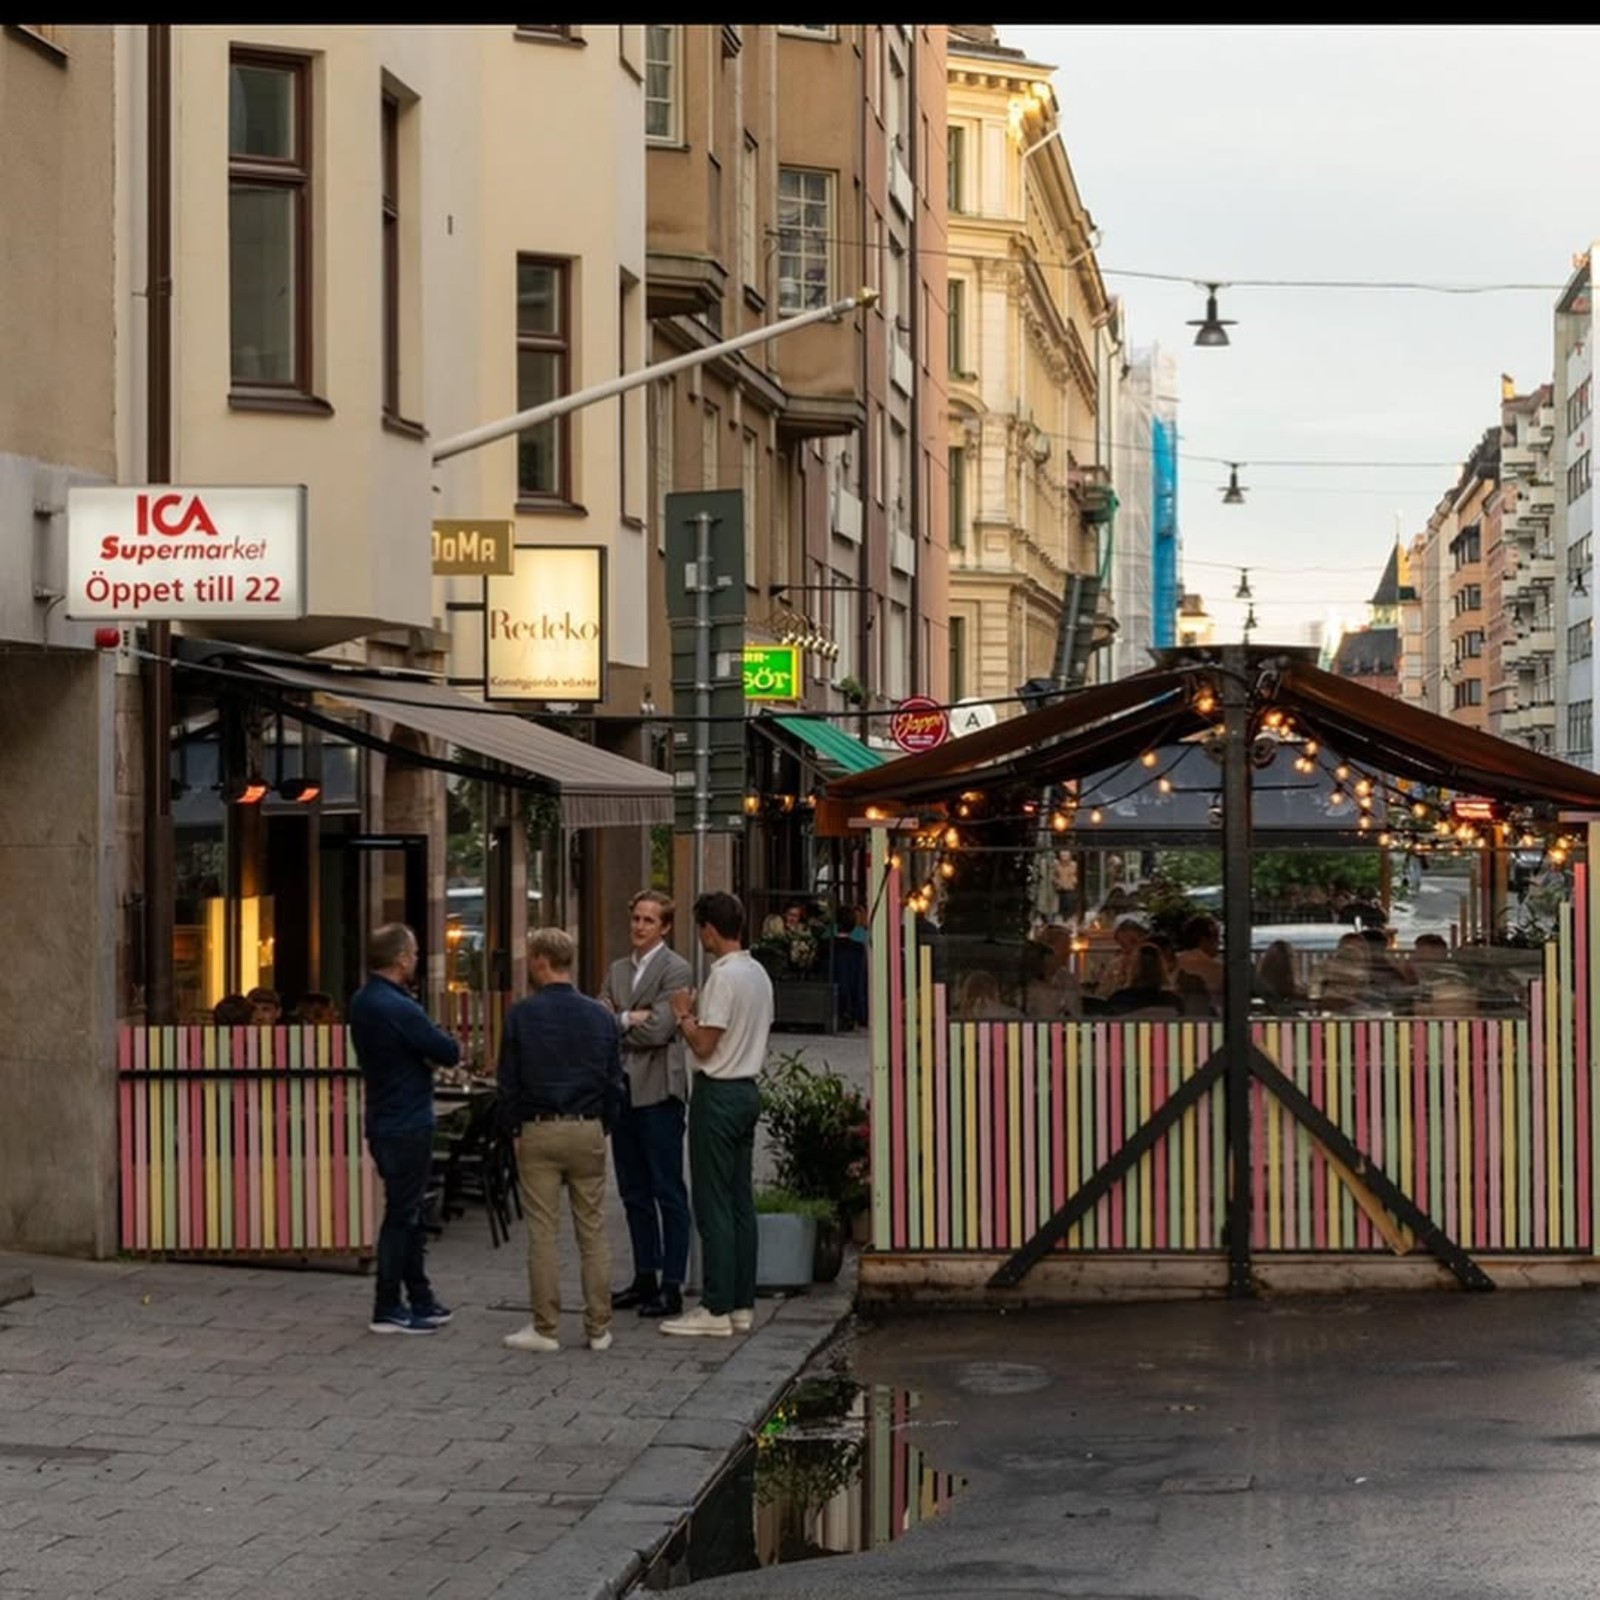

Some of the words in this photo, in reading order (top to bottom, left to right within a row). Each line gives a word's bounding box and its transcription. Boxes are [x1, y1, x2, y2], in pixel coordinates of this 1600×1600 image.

[137, 494, 218, 536] ICA
[100, 535, 267, 565] Supermarket
[86, 571, 184, 609] Öppet
[195, 576, 233, 602] till
[245, 577, 281, 602] 22
[490, 609, 599, 641] Redeko
[965, 712, 981, 728] A
